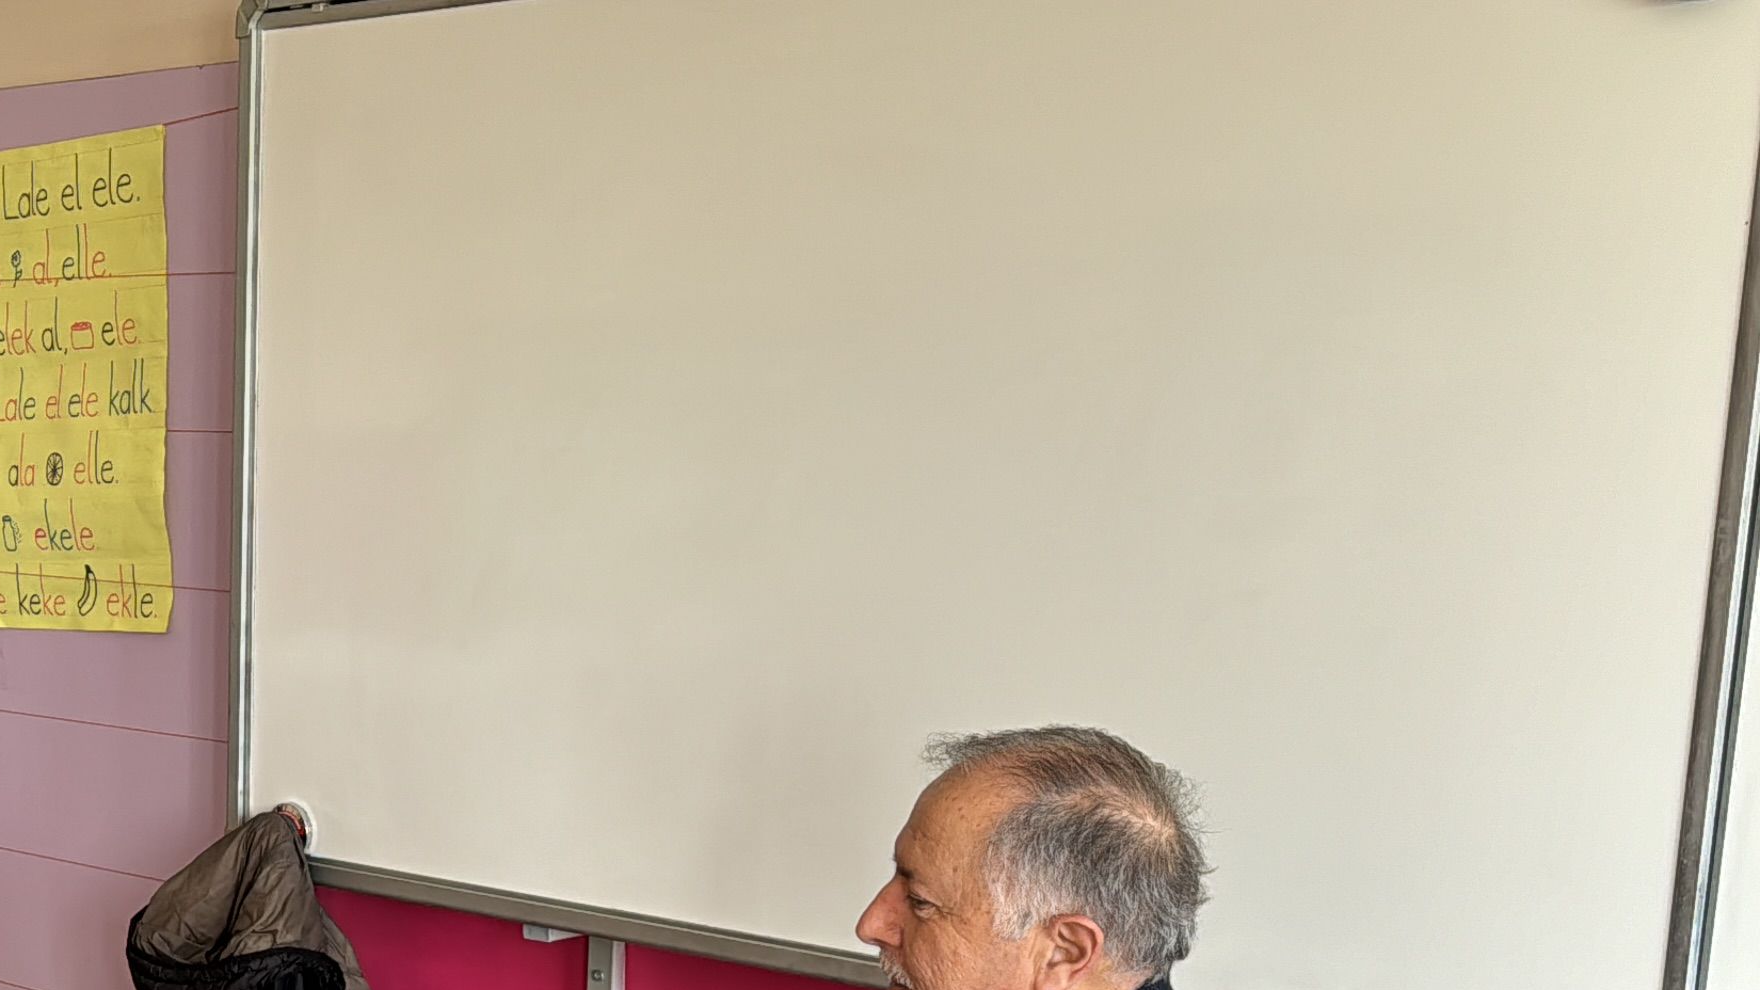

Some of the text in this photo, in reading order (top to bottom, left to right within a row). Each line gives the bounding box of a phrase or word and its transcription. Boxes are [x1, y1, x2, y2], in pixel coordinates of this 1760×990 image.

[2, 160, 51, 220] Lale
[61, 153, 82, 211] el
[92, 147, 140, 207] ele.
[32, 228, 59, 287] al,
[62, 223, 112, 281] elle.
[41, 296, 68, 355] al,
[45, 364, 63, 419] el
[68, 362, 98, 417] ele
[8, 432, 35, 486] ala
[73, 430, 118, 485] elle.
[16, 562, 66, 616] keke
[106, 563, 157, 619] ekle.
